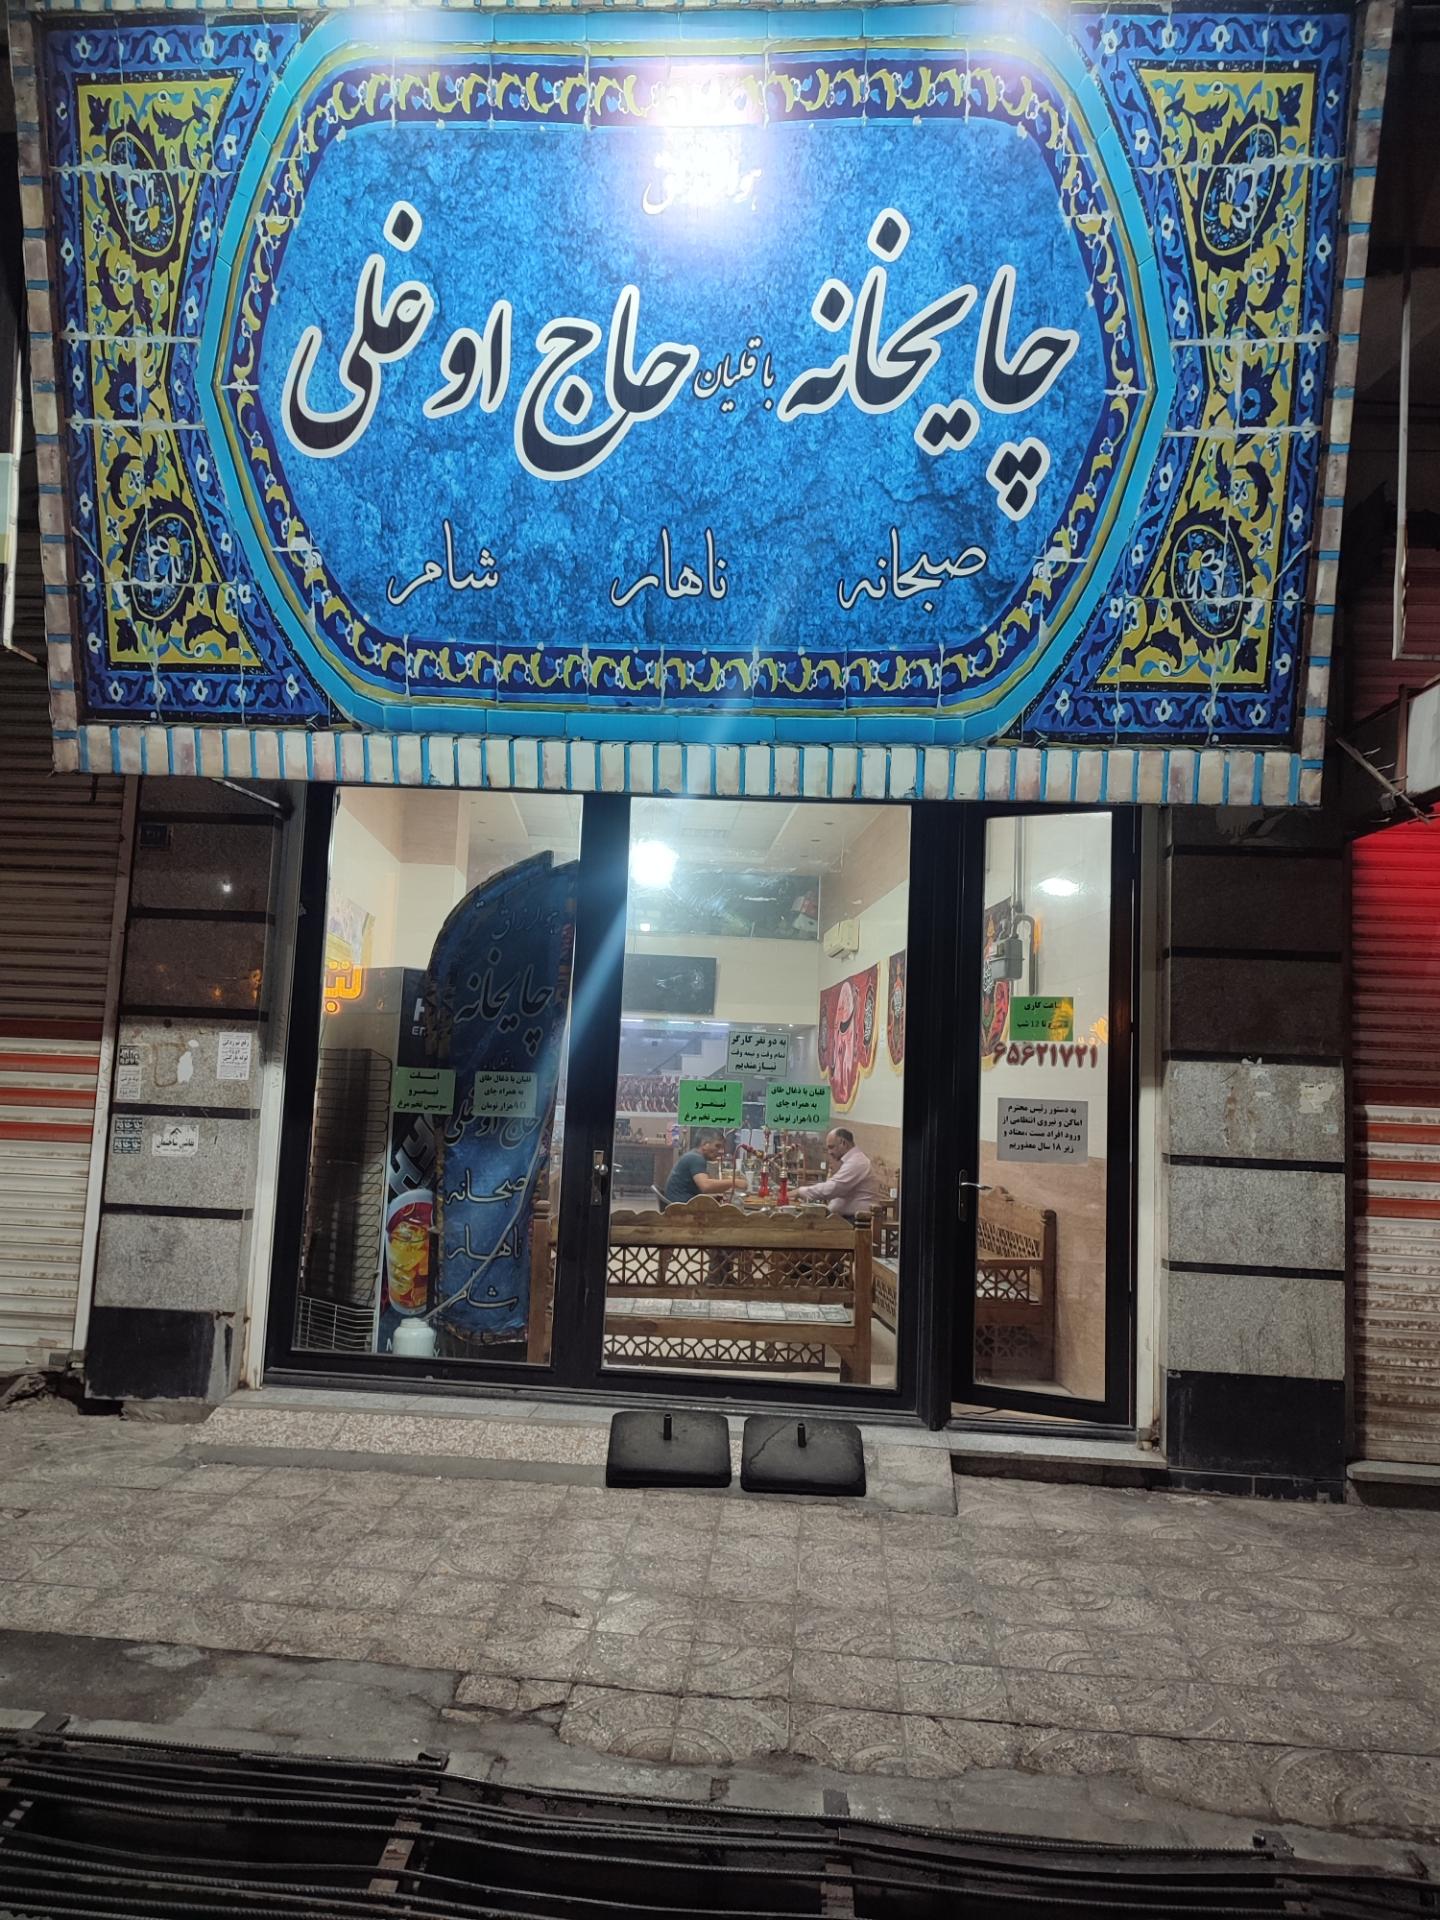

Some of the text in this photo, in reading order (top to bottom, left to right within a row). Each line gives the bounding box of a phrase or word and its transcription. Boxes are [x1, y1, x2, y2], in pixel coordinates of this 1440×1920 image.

[777, 207, 1080, 522] چایخانه
[692, 336, 763, 414] قلیان
[514, 284, 701, 481] حاج
[762, 351, 776, 412] با
[387, 520, 989, 611] صبحانه ناهار شام
[731, 1034, 753, 1046] کارگر
[754, 1036, 766, 1047] نفر
[768, 1038, 777, 1047] دو
[696, 1083, 727, 1092] املت
[695, 1099, 726, 1110] نیمرو
[776, 1099, 790, 1108] چای
[791, 1100, 809, 1109] همراه
[1008, 1104, 1028, 1113] محترم
[1050, 1106, 1069, 1115] دستور
[684, 1112, 697, 1122] مرغ
[698, 1113, 710, 1123] تخم
[1037, 1118, 1057, 1127] نیروی
[1063, 1119, 1083, 1128] اماکن
[1046, 1130, 1064, 1140] افراد
[1064, 1132, 1081, 1141] ورود
[1037, 1142, 1051, 1151] سال
